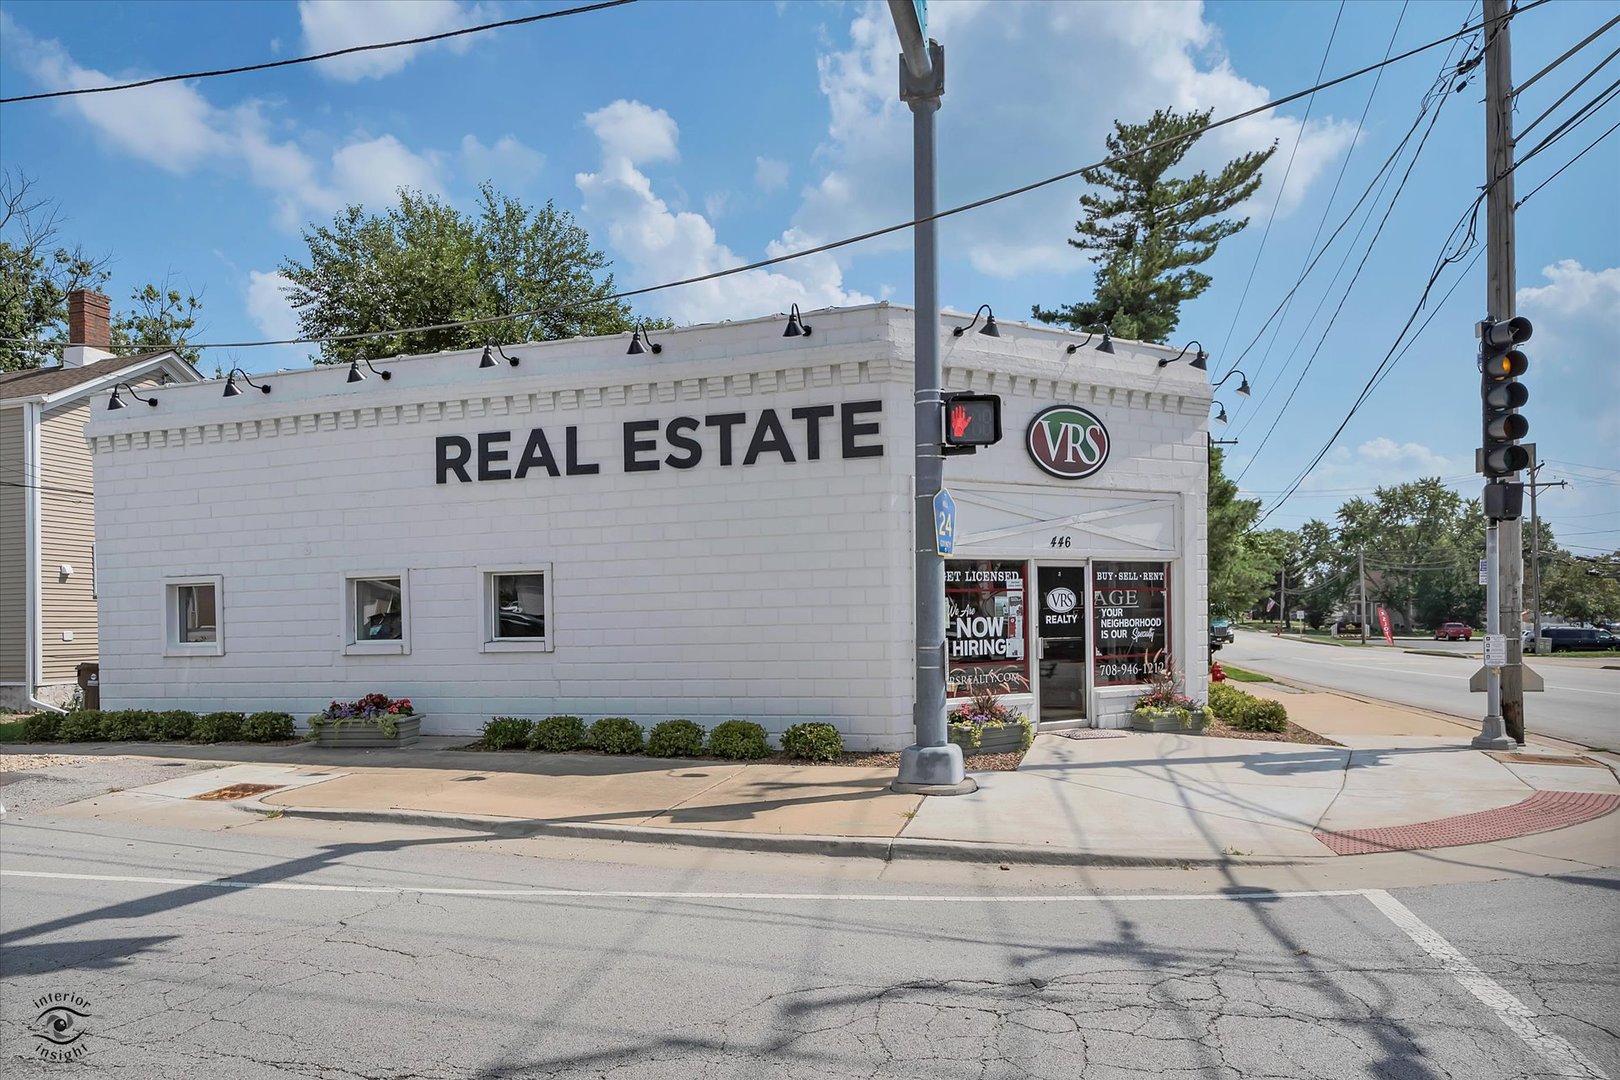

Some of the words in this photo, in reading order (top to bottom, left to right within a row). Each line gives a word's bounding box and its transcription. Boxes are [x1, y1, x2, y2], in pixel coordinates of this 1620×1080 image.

[435, 425, 600, 485] REAL
[623, 400, 884, 473] ESTATE
[1039, 419, 1101, 465] VRS
[939, 511, 951, 537] 24
[1050, 535, 1072, 549] 446
[944, 570, 961, 582] ET
[965, 571, 1019, 582] LICENSED
[1143, 571, 1164, 581] RENT
[1051, 592, 1074, 608] VRS
[1045, 614, 1077, 624] REALTY
[1100, 608, 1123, 617] YOUR
[956, 616, 1004, 639] NOW
[1100, 618, 1162, 628] NEIGHBORHOOD
[1101, 630, 1109, 639] IS
[1110, 630, 1128, 639] OUR
[952, 638, 1006, 657] HIRING
